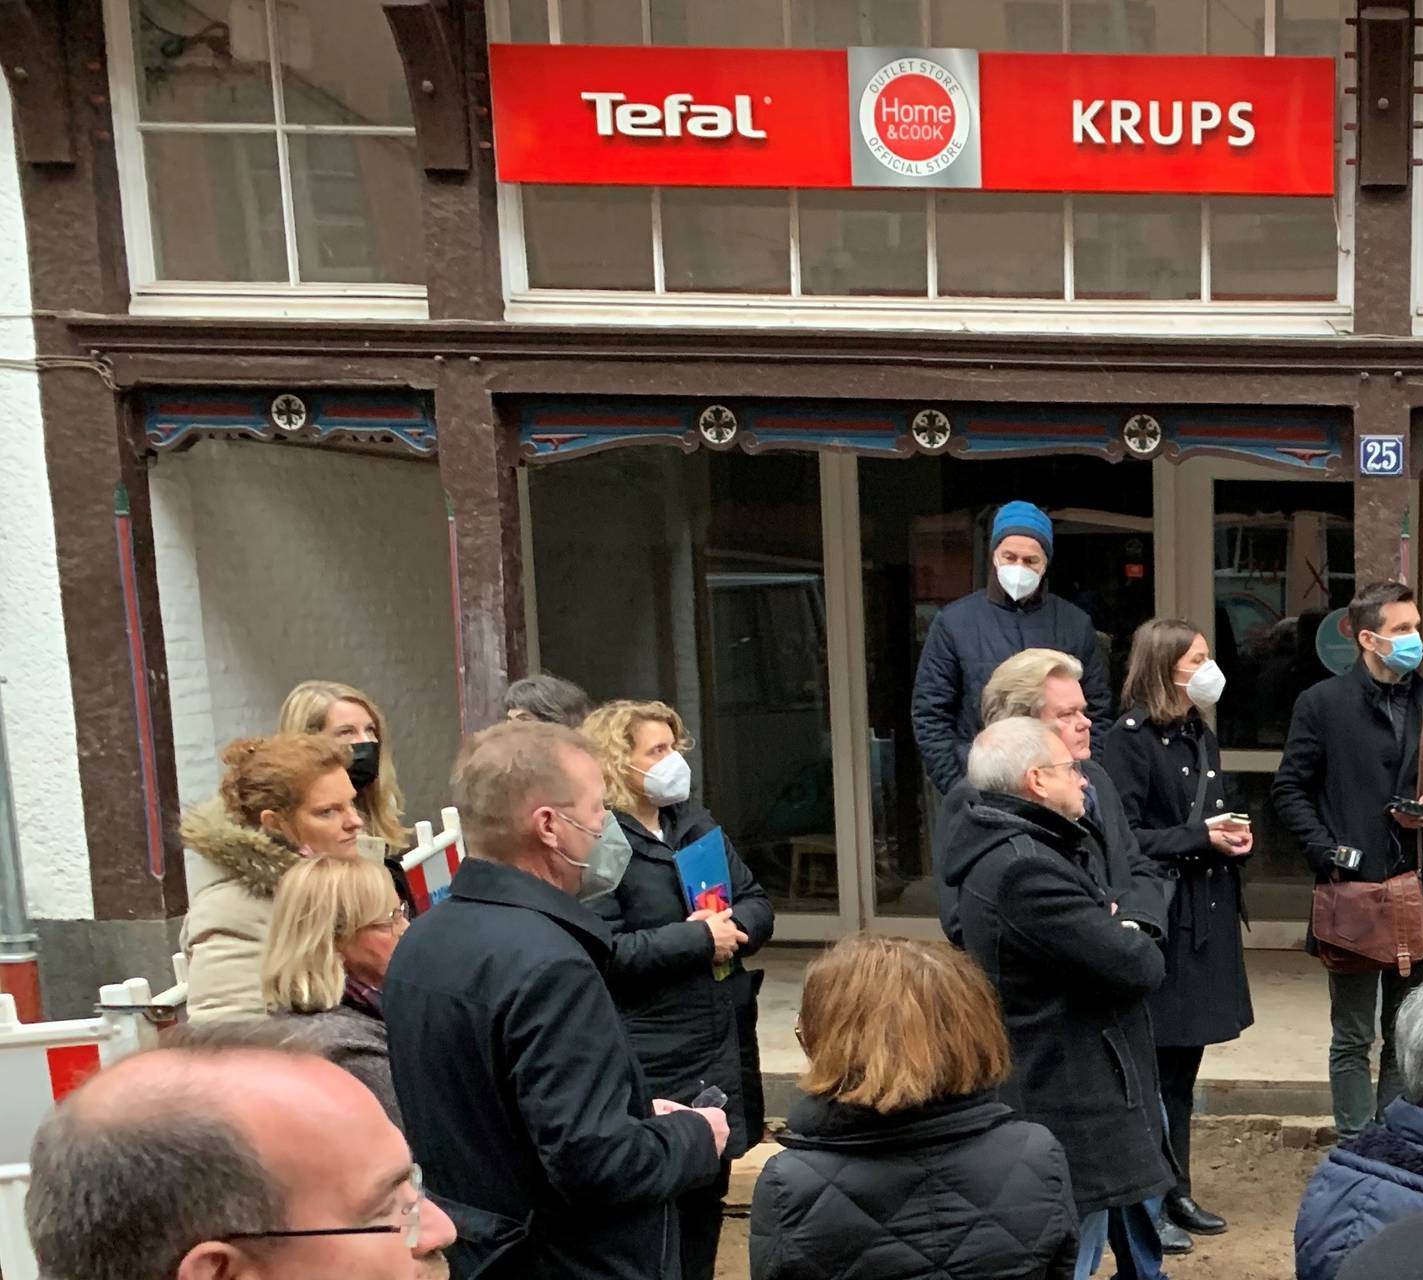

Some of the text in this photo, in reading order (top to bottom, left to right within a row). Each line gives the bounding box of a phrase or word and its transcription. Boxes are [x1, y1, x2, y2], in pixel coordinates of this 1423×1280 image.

[869, 60, 959, 95] OUTLET STORE
[580, 92, 767, 138] Tefal
[881, 97, 952, 124] Home
[1072, 99, 1256, 147] KRUPS
[886, 124, 944, 140] &COOK
[868, 136, 962, 174] OFFICIAL STORE
[1366, 441, 1397, 470] 25
